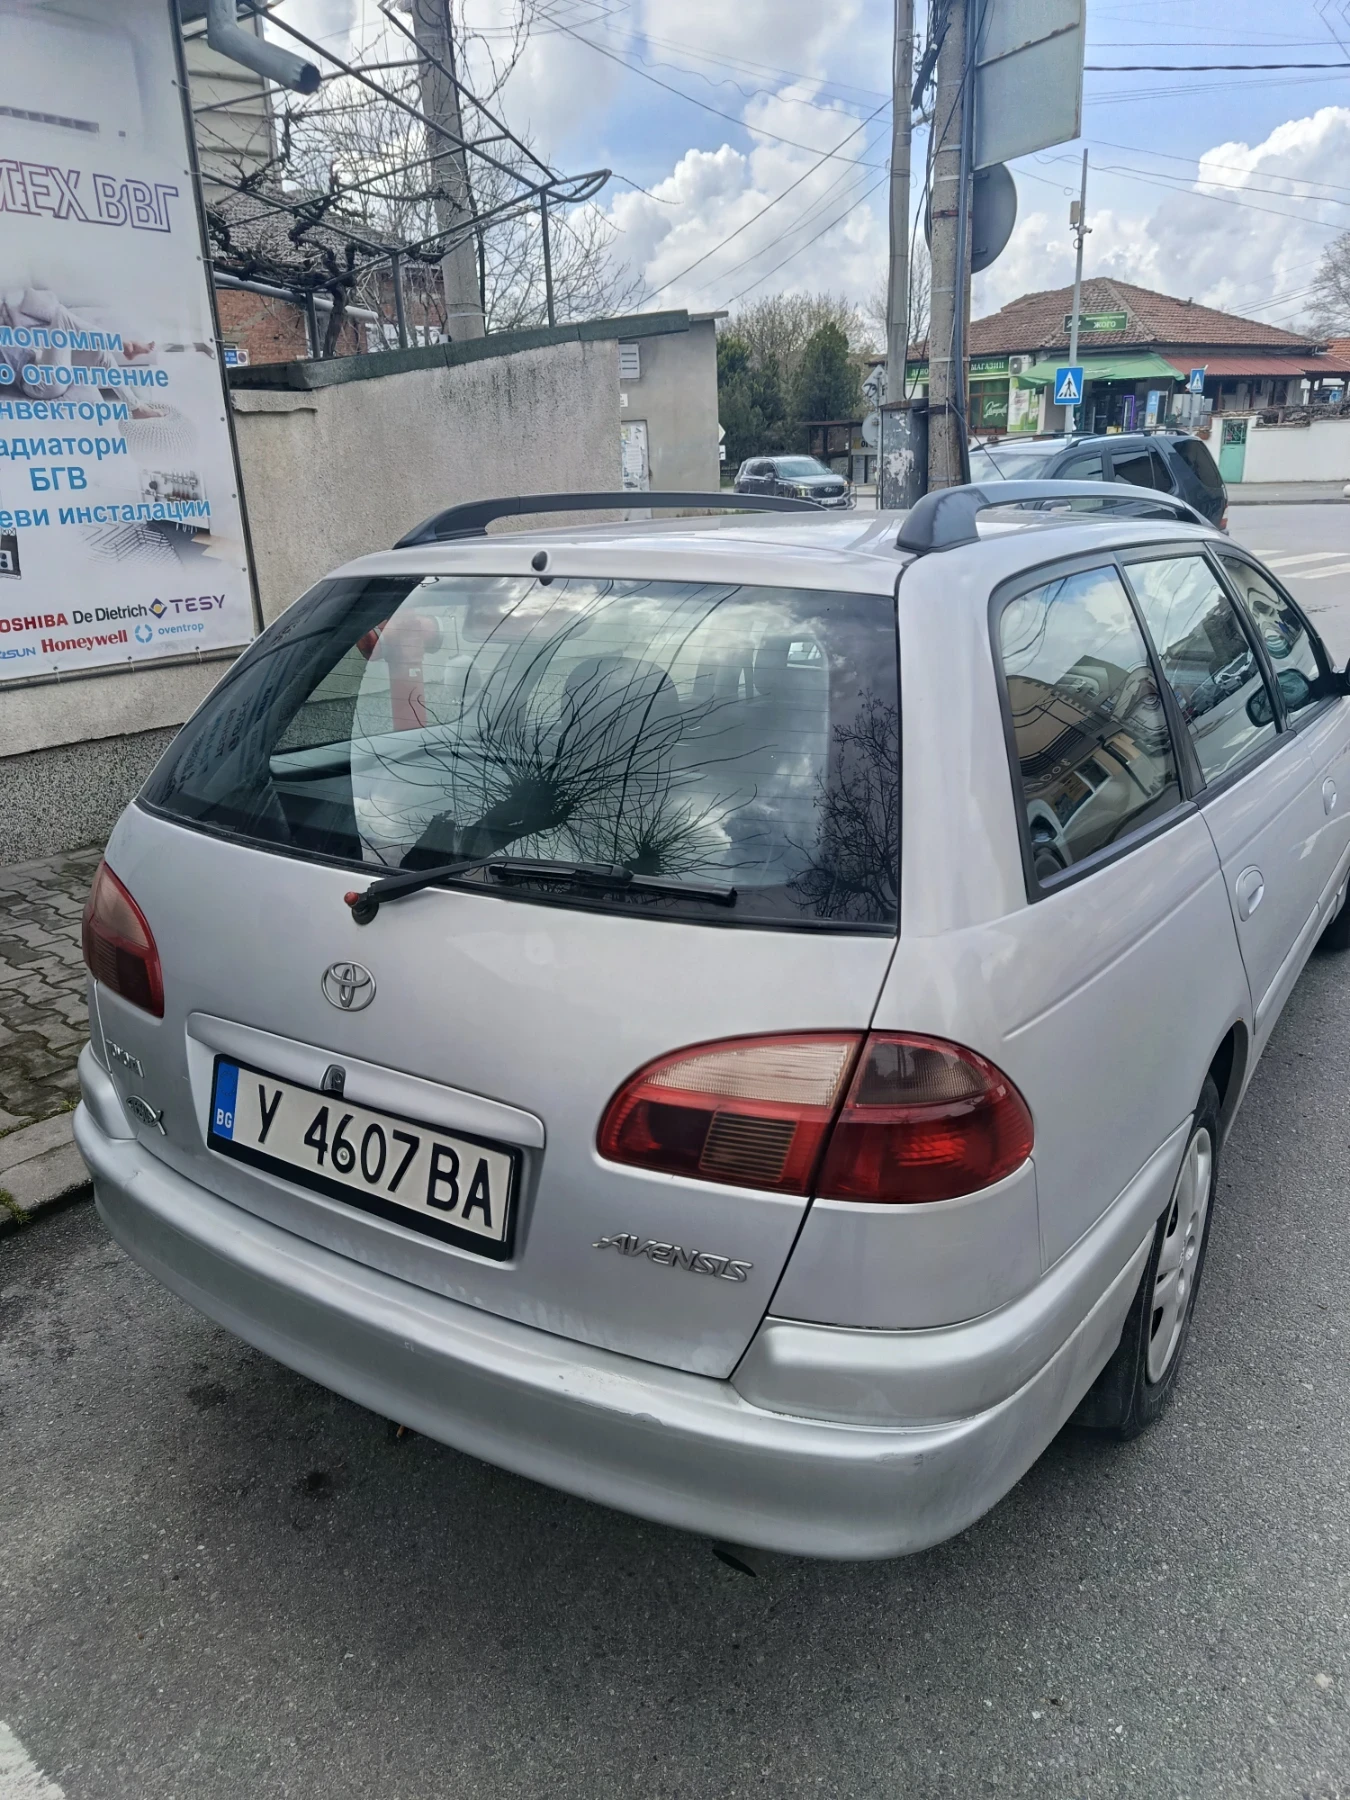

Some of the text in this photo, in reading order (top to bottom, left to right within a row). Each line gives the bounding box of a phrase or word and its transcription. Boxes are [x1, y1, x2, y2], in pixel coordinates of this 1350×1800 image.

[23, 364, 169, 388] отопление
[970, 361, 1005, 371] МАГАЗИН
[29, 466, 88, 492] БГВ
[59, 500, 212, 526] инсталации
[72, 604, 148, 625] De Dietrich
[169, 594, 226, 614] TESY
[157, 622, 205, 636] oventrop
[40, 629, 128, 654] Honeywell
[216, 1107, 233, 1129] BG
[303, 1105, 421, 1194] 4607
[592, 1232, 753, 1283] AVENSIS
